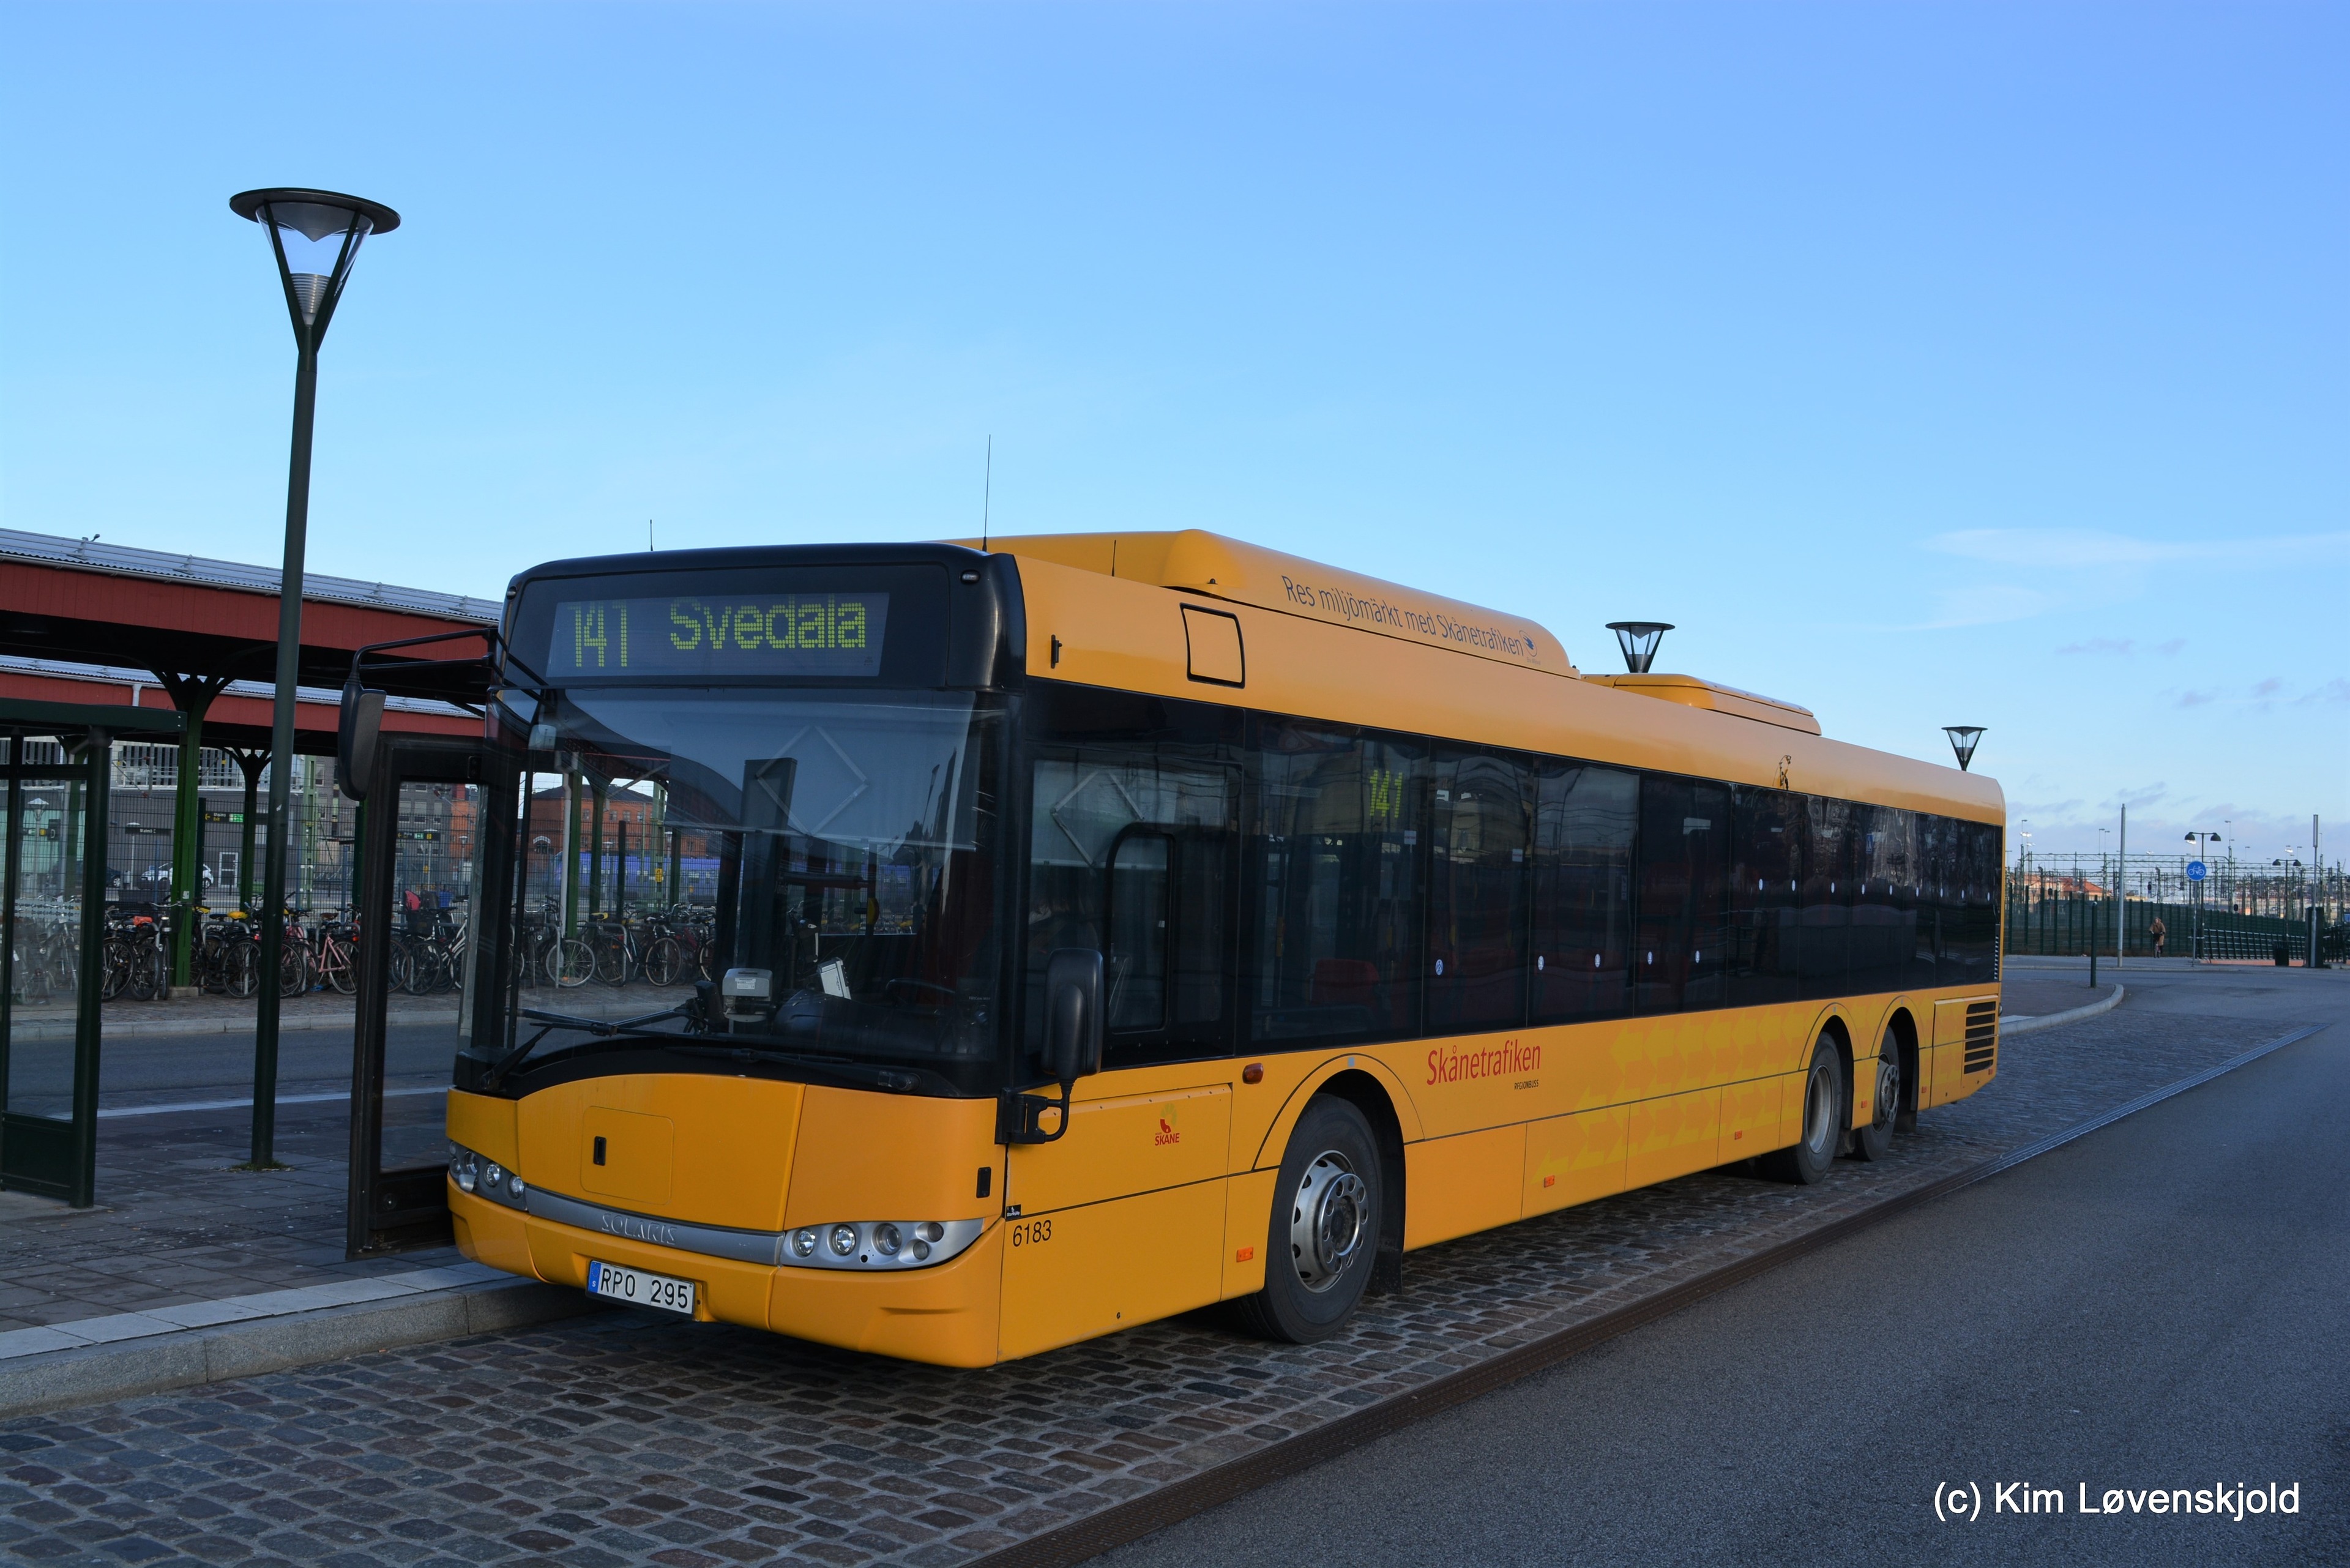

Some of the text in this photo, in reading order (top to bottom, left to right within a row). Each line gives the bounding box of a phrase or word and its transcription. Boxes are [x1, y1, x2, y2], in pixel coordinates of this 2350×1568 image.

[567, 595, 865, 667] 141 Svedala
[1281, 575, 1524, 656] Res miljömärkt med Skånetrafiken
[1370, 769, 1403, 818] 141
[1427, 1039, 1540, 1085] Skånetrafiken
[602, 1212, 677, 1245] SOLARIS
[1013, 1219, 1051, 1247] 6183
[600, 1267, 688, 1309] RPO 295
